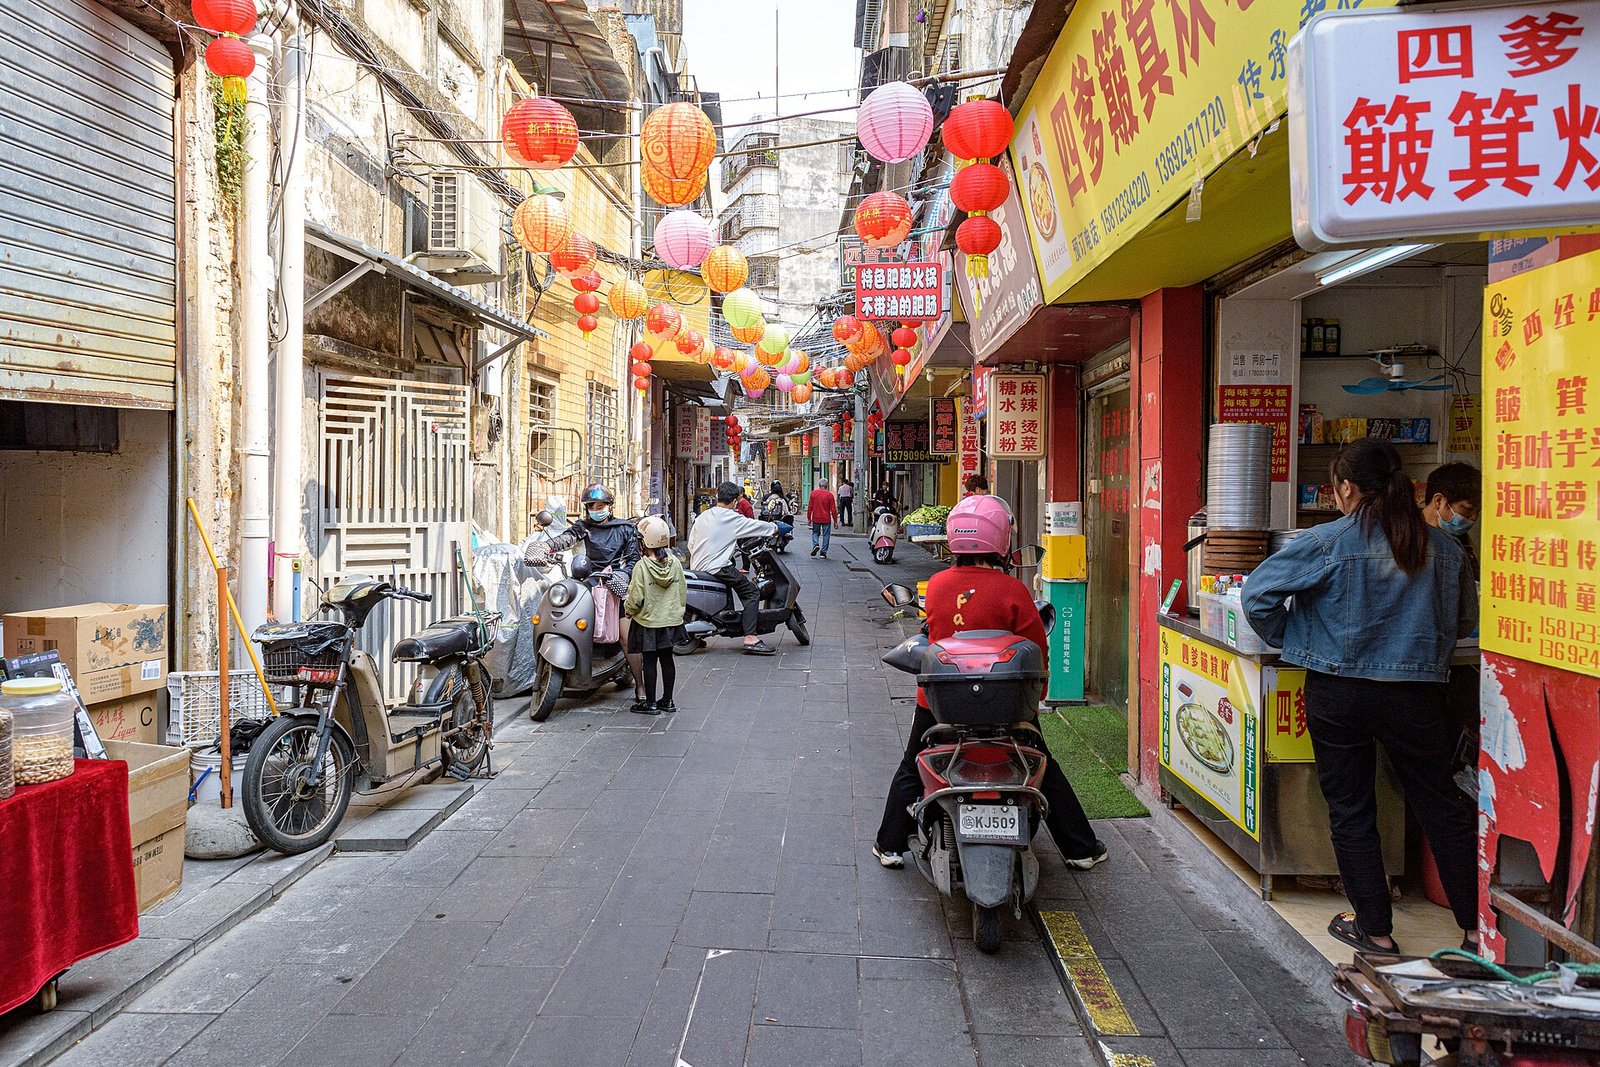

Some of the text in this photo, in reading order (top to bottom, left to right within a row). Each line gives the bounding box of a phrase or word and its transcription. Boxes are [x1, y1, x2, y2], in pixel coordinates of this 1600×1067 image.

[1397, 12, 1585, 84] 四爹
[1050, 0, 1255, 207] 四爹簸箕炊
[1155, 95, 1226, 185] 13692471720
[861, 266, 938, 290] 特色肥肠火锅
[888, 424, 929, 450] 远香牛
[1495, 480, 1600, 521] 海味萝
[1491, 534, 1568, 568] 传承老档
[1491, 571, 1567, 609] 独特风味
[1539, 616, 1600, 645] 158123
[140, 706, 153, 727] C
[975, 816, 1016, 829] KJ509
